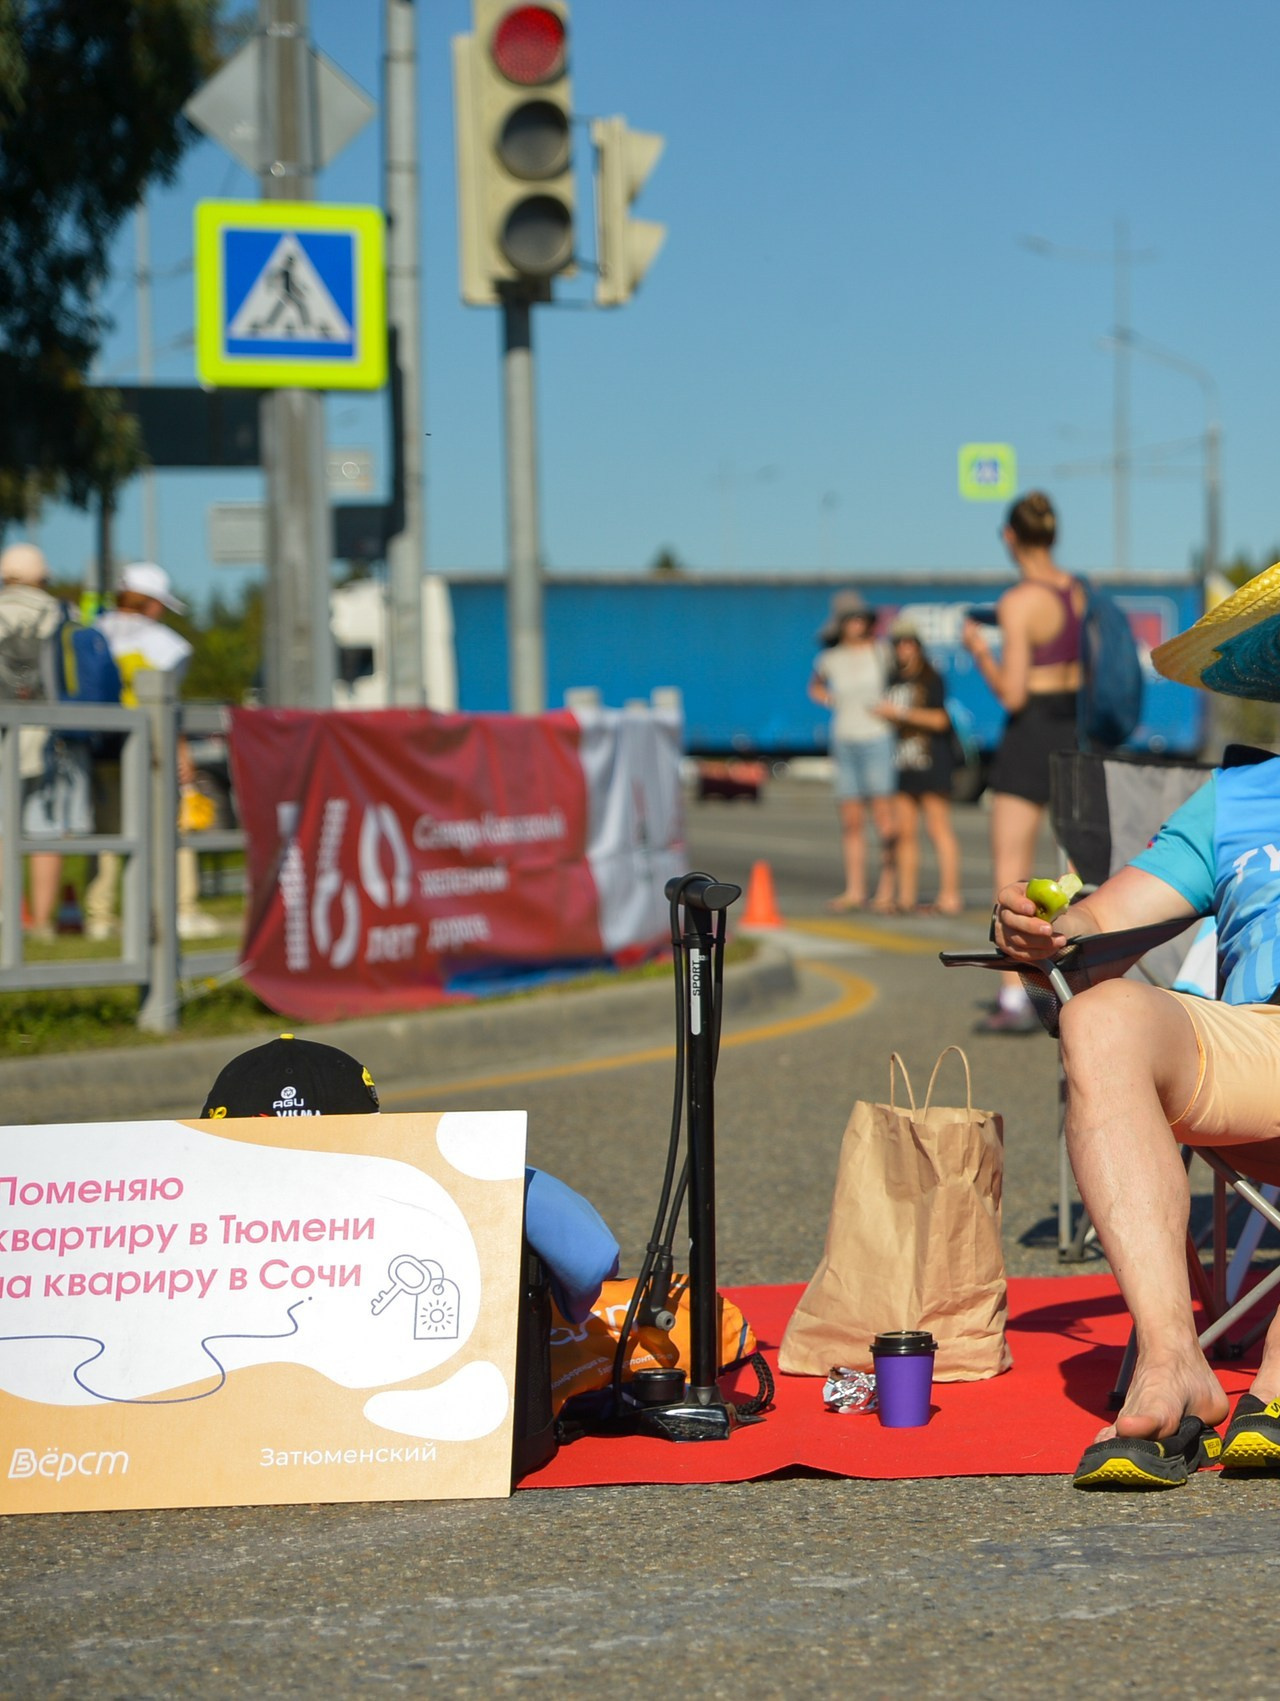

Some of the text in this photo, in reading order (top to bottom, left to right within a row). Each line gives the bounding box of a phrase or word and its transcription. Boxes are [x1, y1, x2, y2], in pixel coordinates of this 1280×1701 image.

[272, 1097, 305, 1110] AGU
[189, 1222, 208, 1245] в
[220, 1214, 375, 1244] Тюмени
[44, 1268, 217, 1302] квариру
[229, 1267, 248, 1291] в
[260, 1259, 361, 1290] Сочи
[259, 1442, 438, 1468] Затюменский
